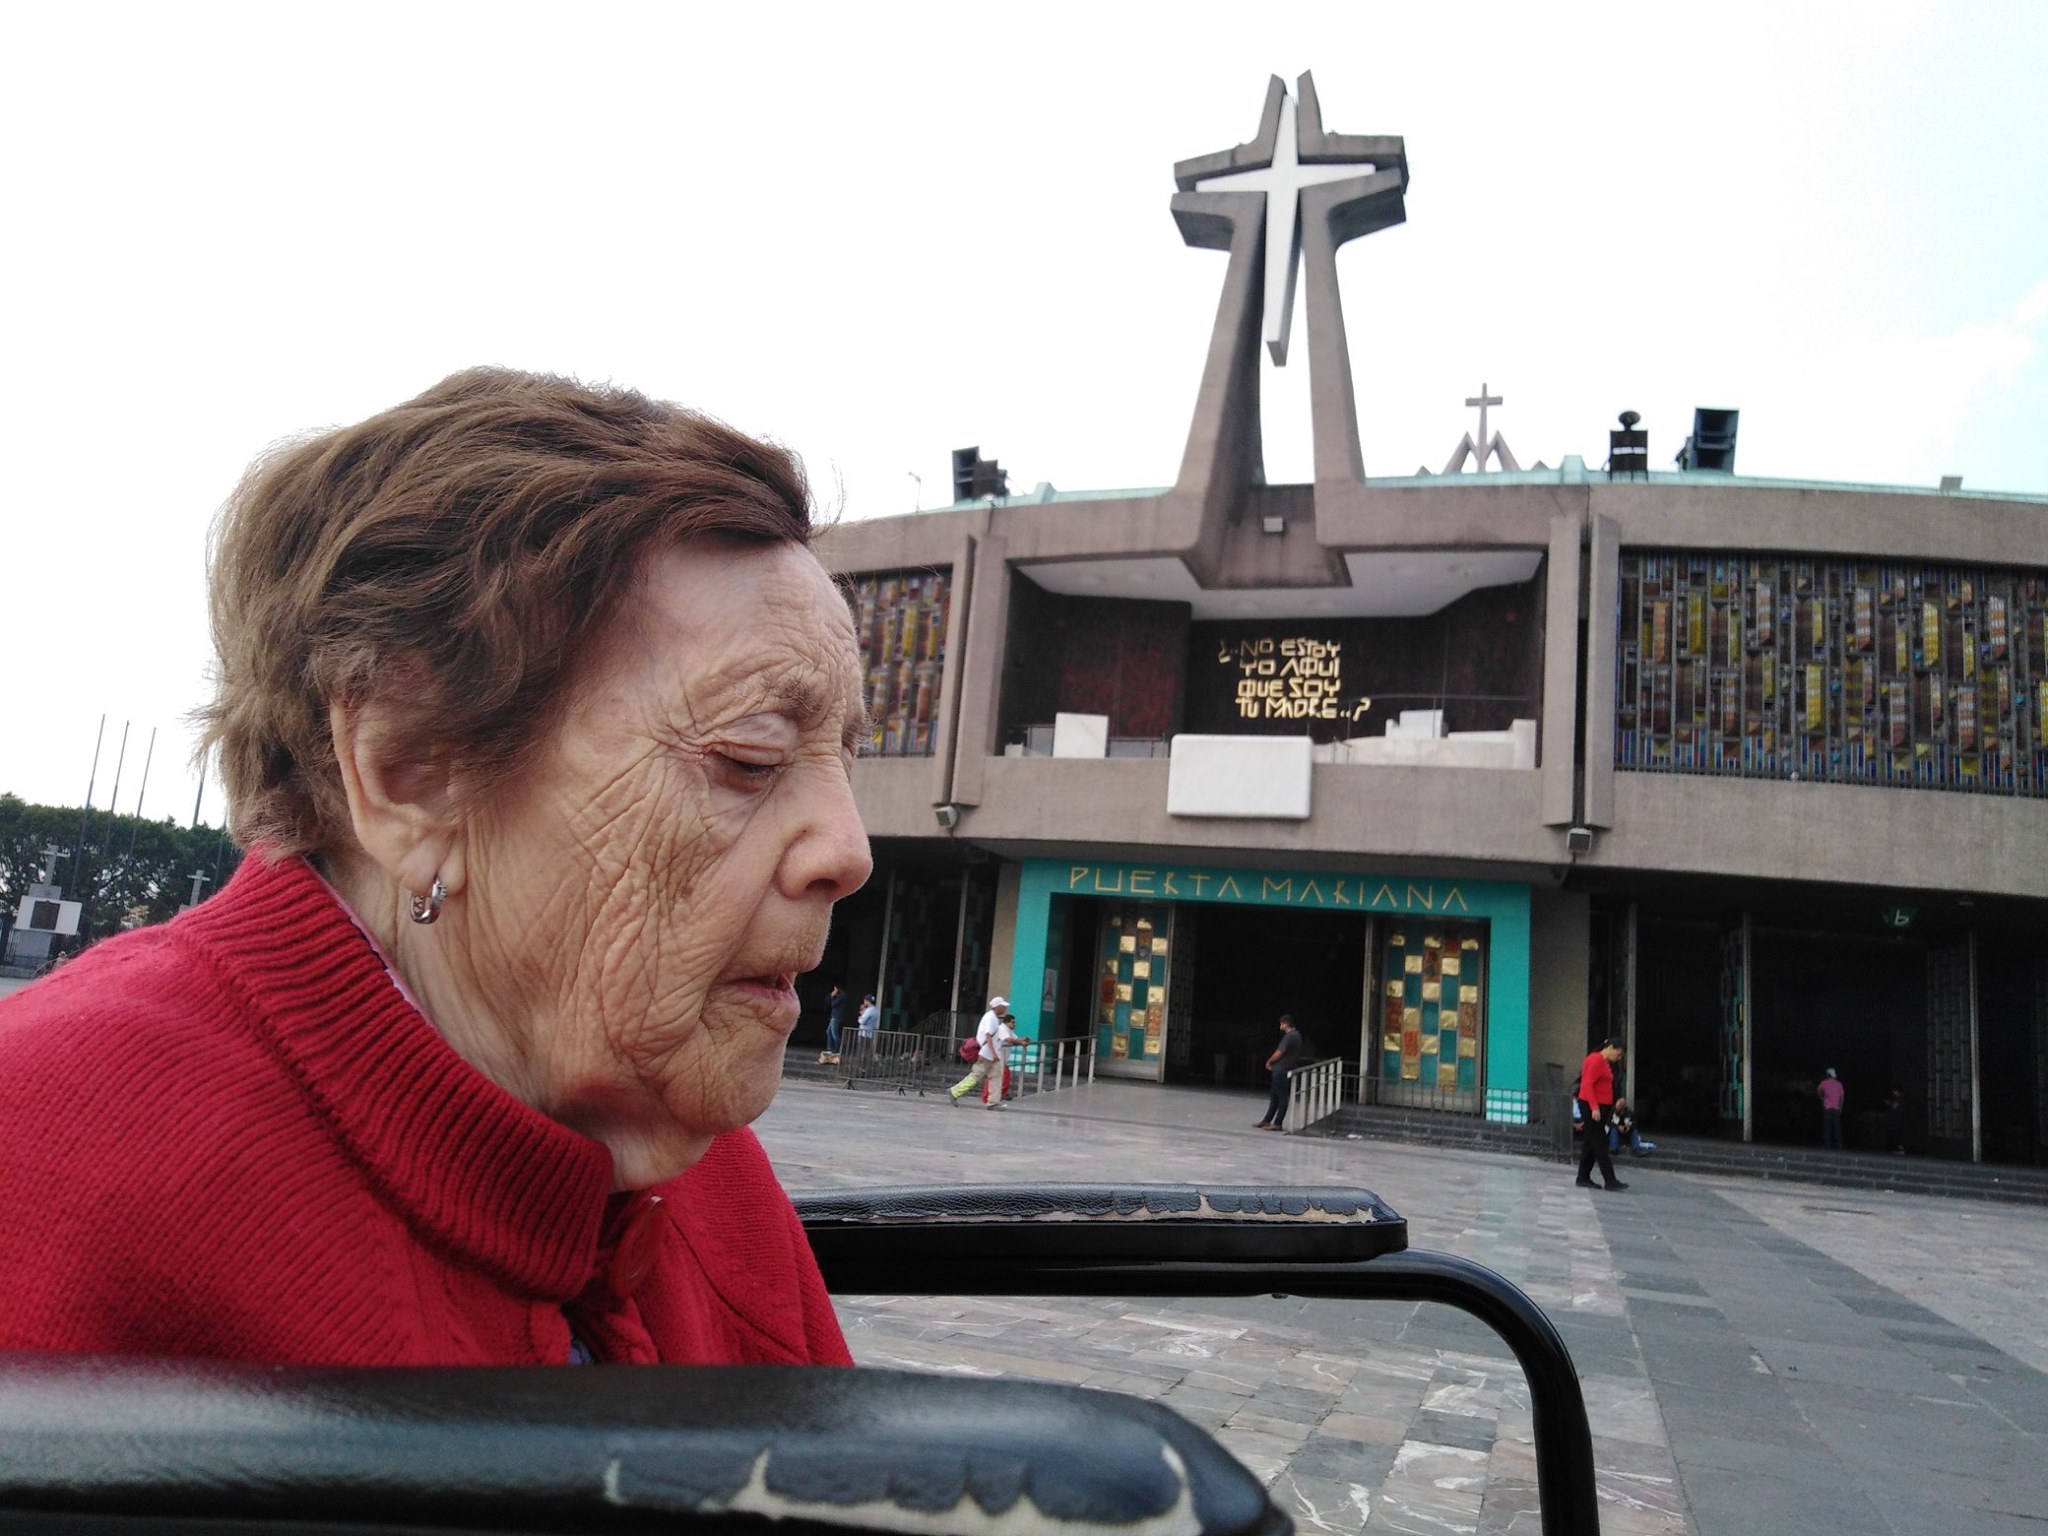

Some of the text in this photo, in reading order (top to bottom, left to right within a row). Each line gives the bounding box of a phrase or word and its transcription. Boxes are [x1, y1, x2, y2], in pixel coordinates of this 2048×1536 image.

[1280, 637, 1341, 657] ESTOY
[1239, 657, 1276, 677] YO
[1237, 676, 1341, 699] QUE SOY
[1234, 697, 1260, 719] TU
[1069, 866, 1468, 911] PUERTA MARIANA
